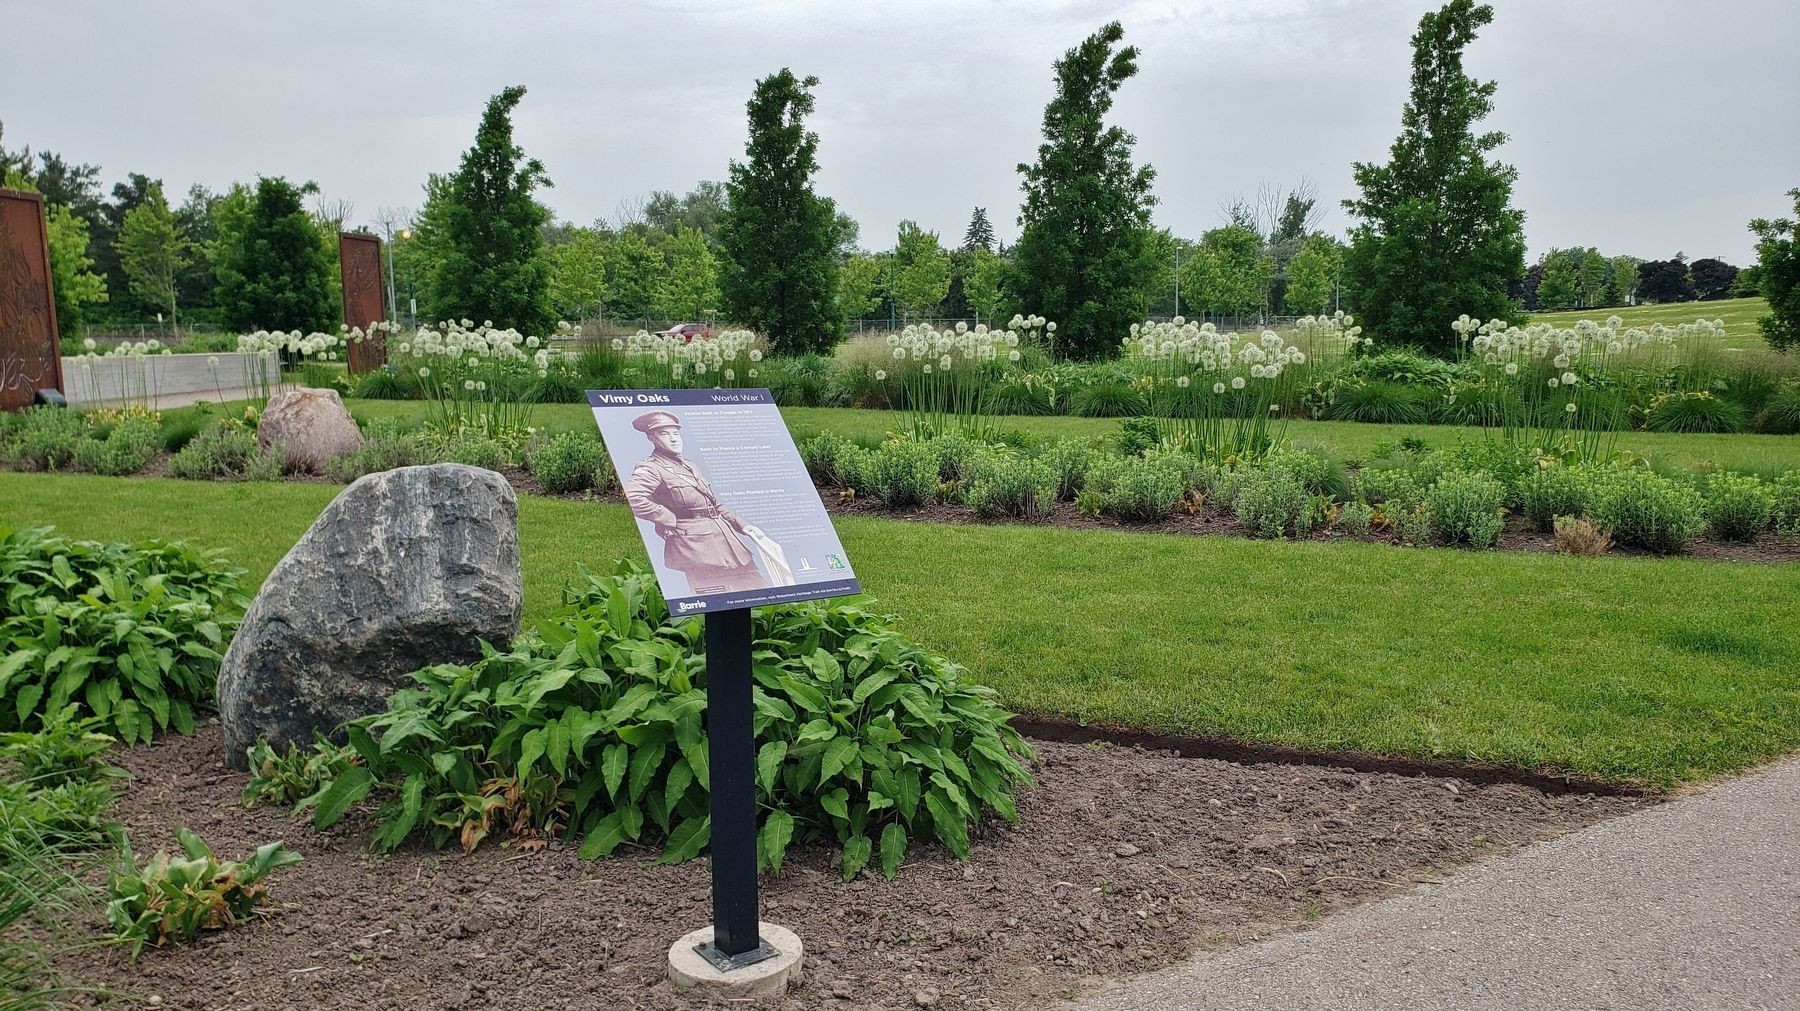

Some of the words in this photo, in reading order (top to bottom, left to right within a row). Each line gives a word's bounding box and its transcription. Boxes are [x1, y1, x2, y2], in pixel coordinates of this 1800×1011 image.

[599, 394, 633, 404] Vimy
[637, 394, 670, 403] Oaks
[680, 600, 707, 610] Barrie
